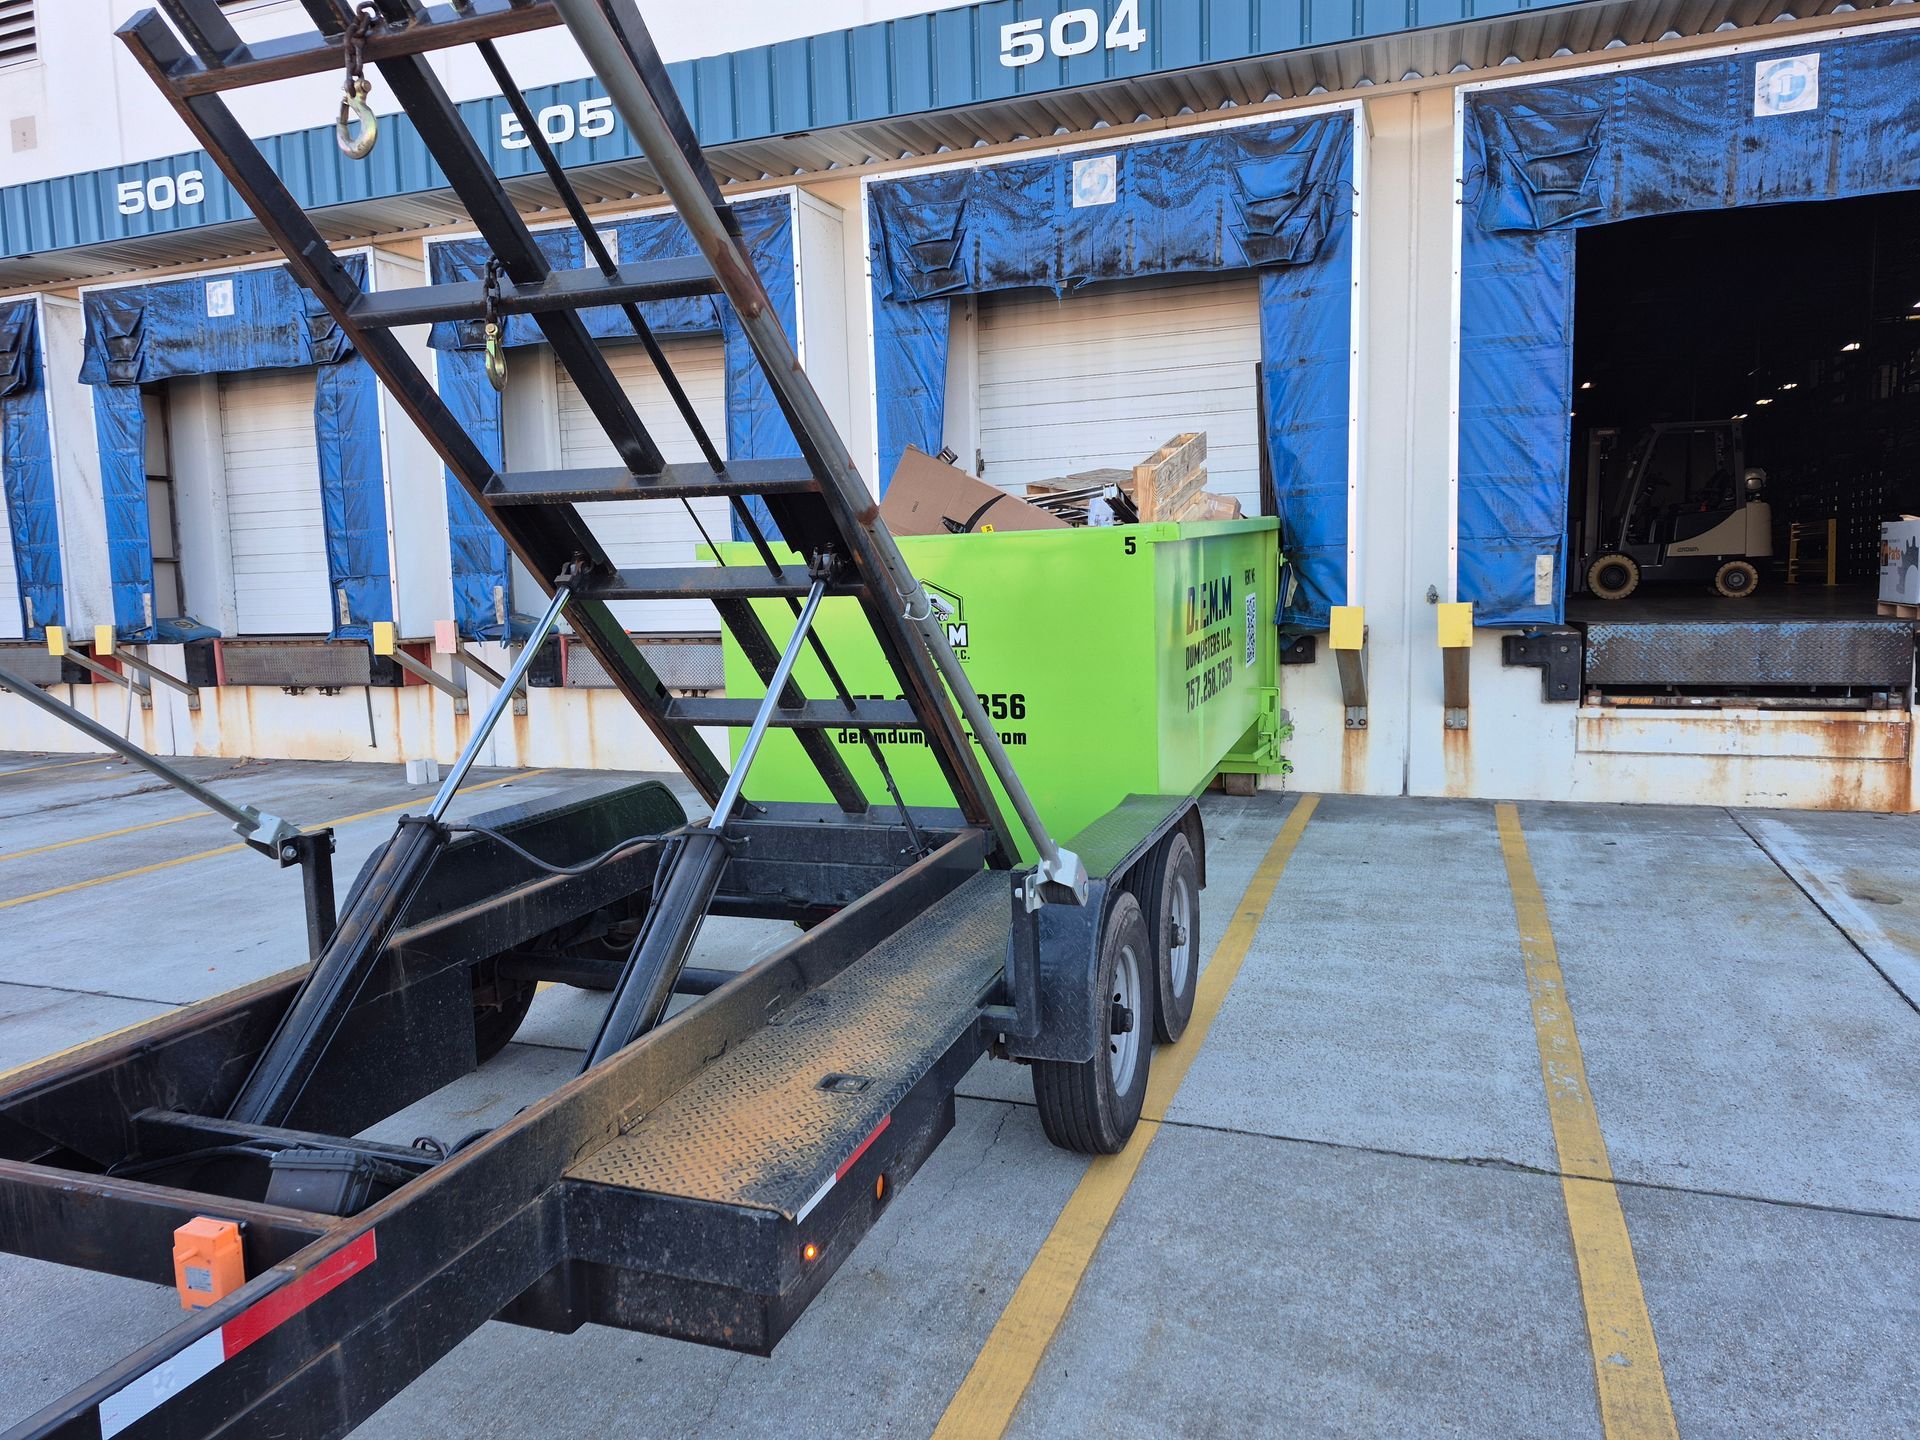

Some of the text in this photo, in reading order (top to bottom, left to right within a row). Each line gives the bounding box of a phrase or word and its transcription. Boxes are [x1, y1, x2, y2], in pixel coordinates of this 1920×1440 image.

[1000, 0, 1147, 67] 504
[501, 97, 615, 149] 505
[117, 170, 205, 215] 506
[1124, 536, 1136, 555] 5
[1186, 631, 1220, 671] DUMPSTERS
